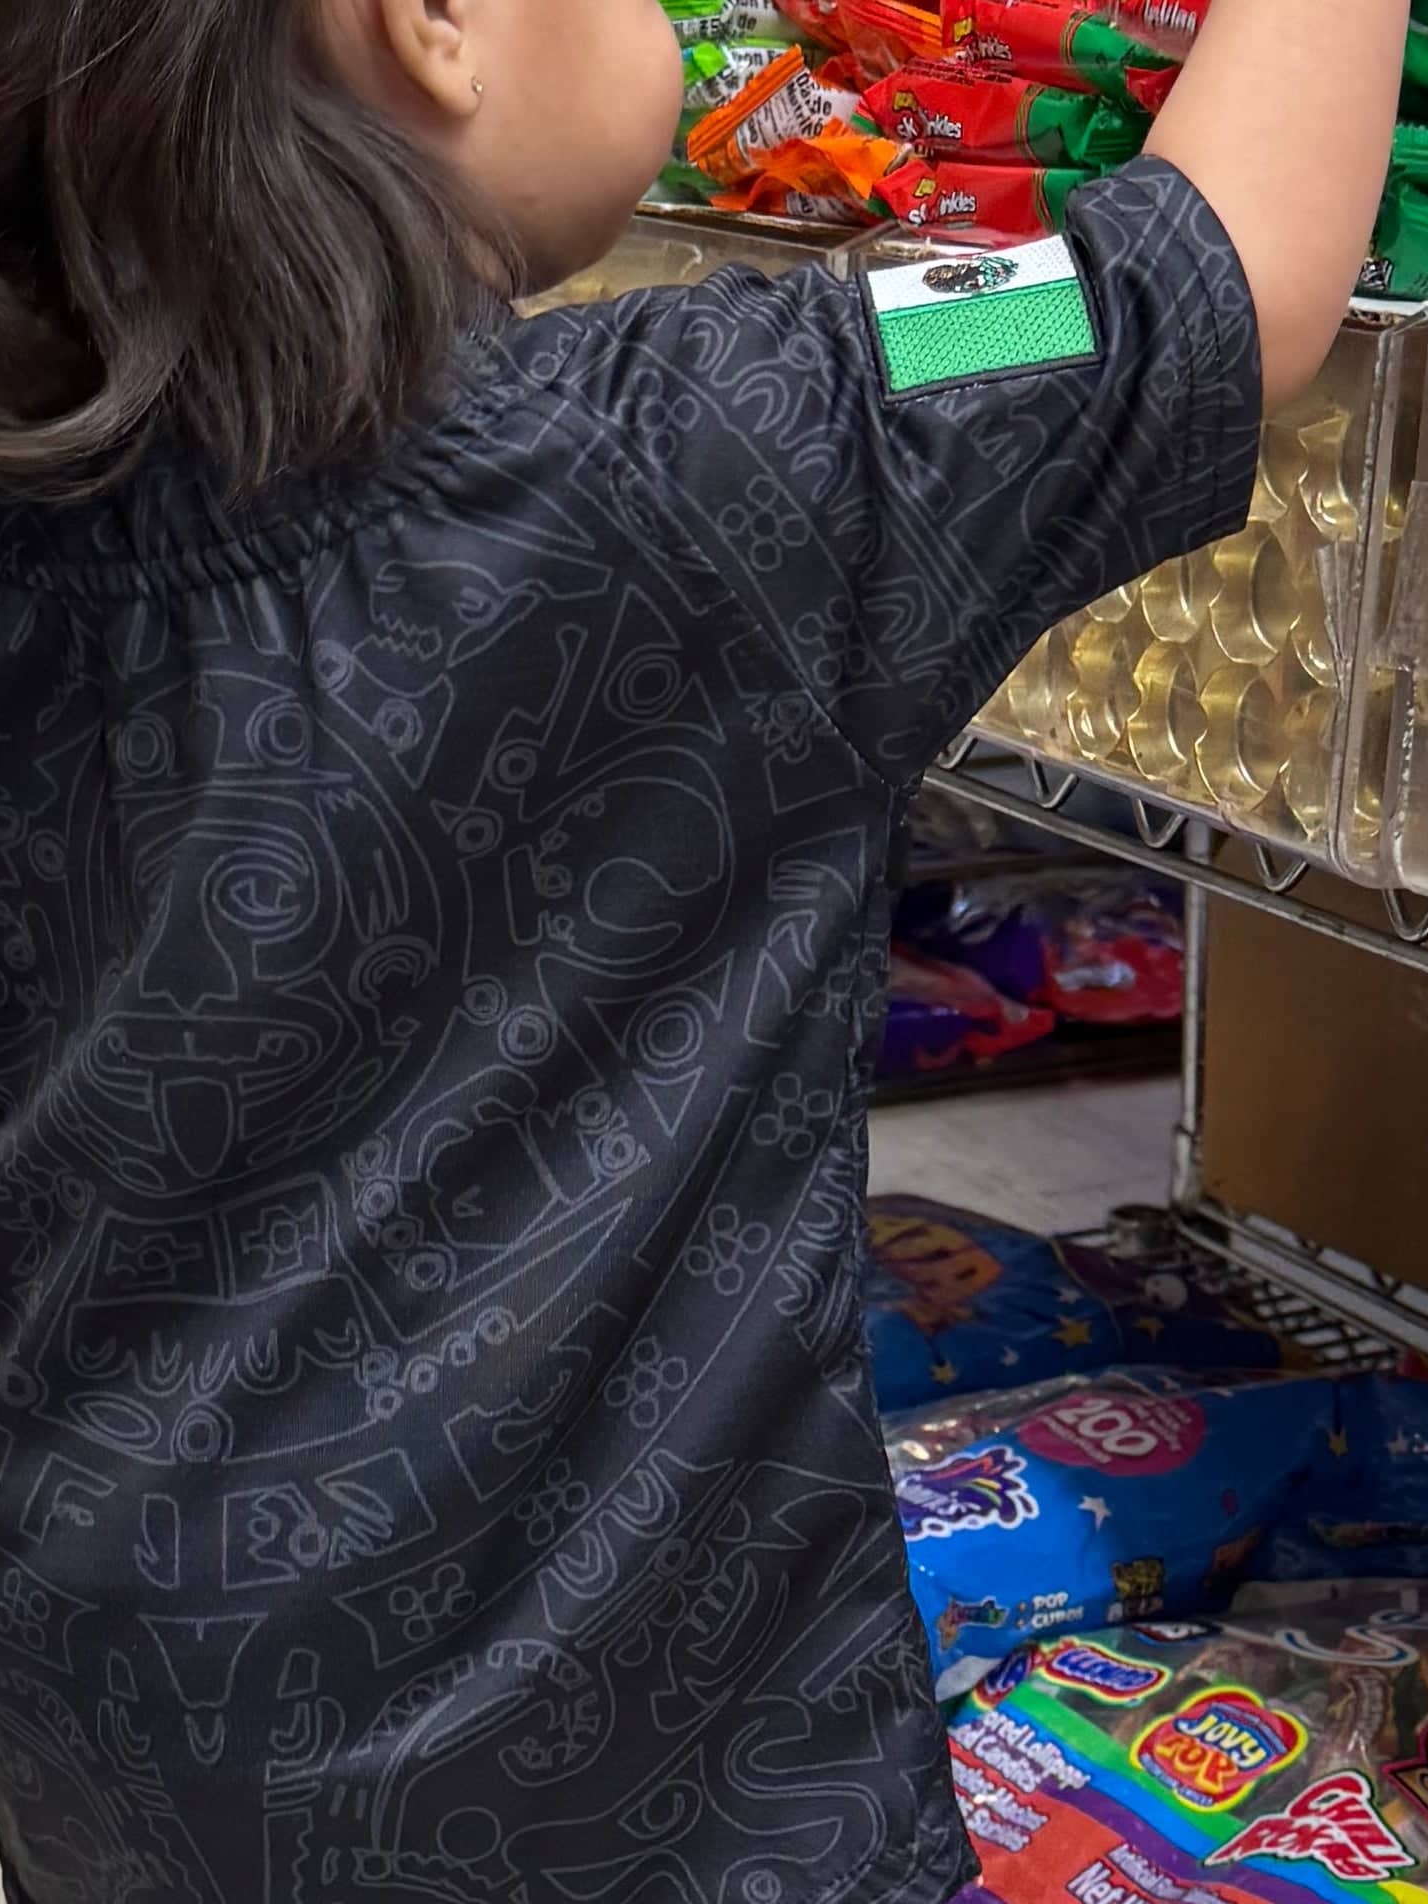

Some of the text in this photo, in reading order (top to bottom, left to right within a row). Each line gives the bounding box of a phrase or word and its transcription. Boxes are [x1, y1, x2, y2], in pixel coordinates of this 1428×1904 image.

[1061, 1396, 1155, 1457] 200
[1033, 1592, 1070, 1612] POP
[1176, 1710, 1269, 1768] JOVY
